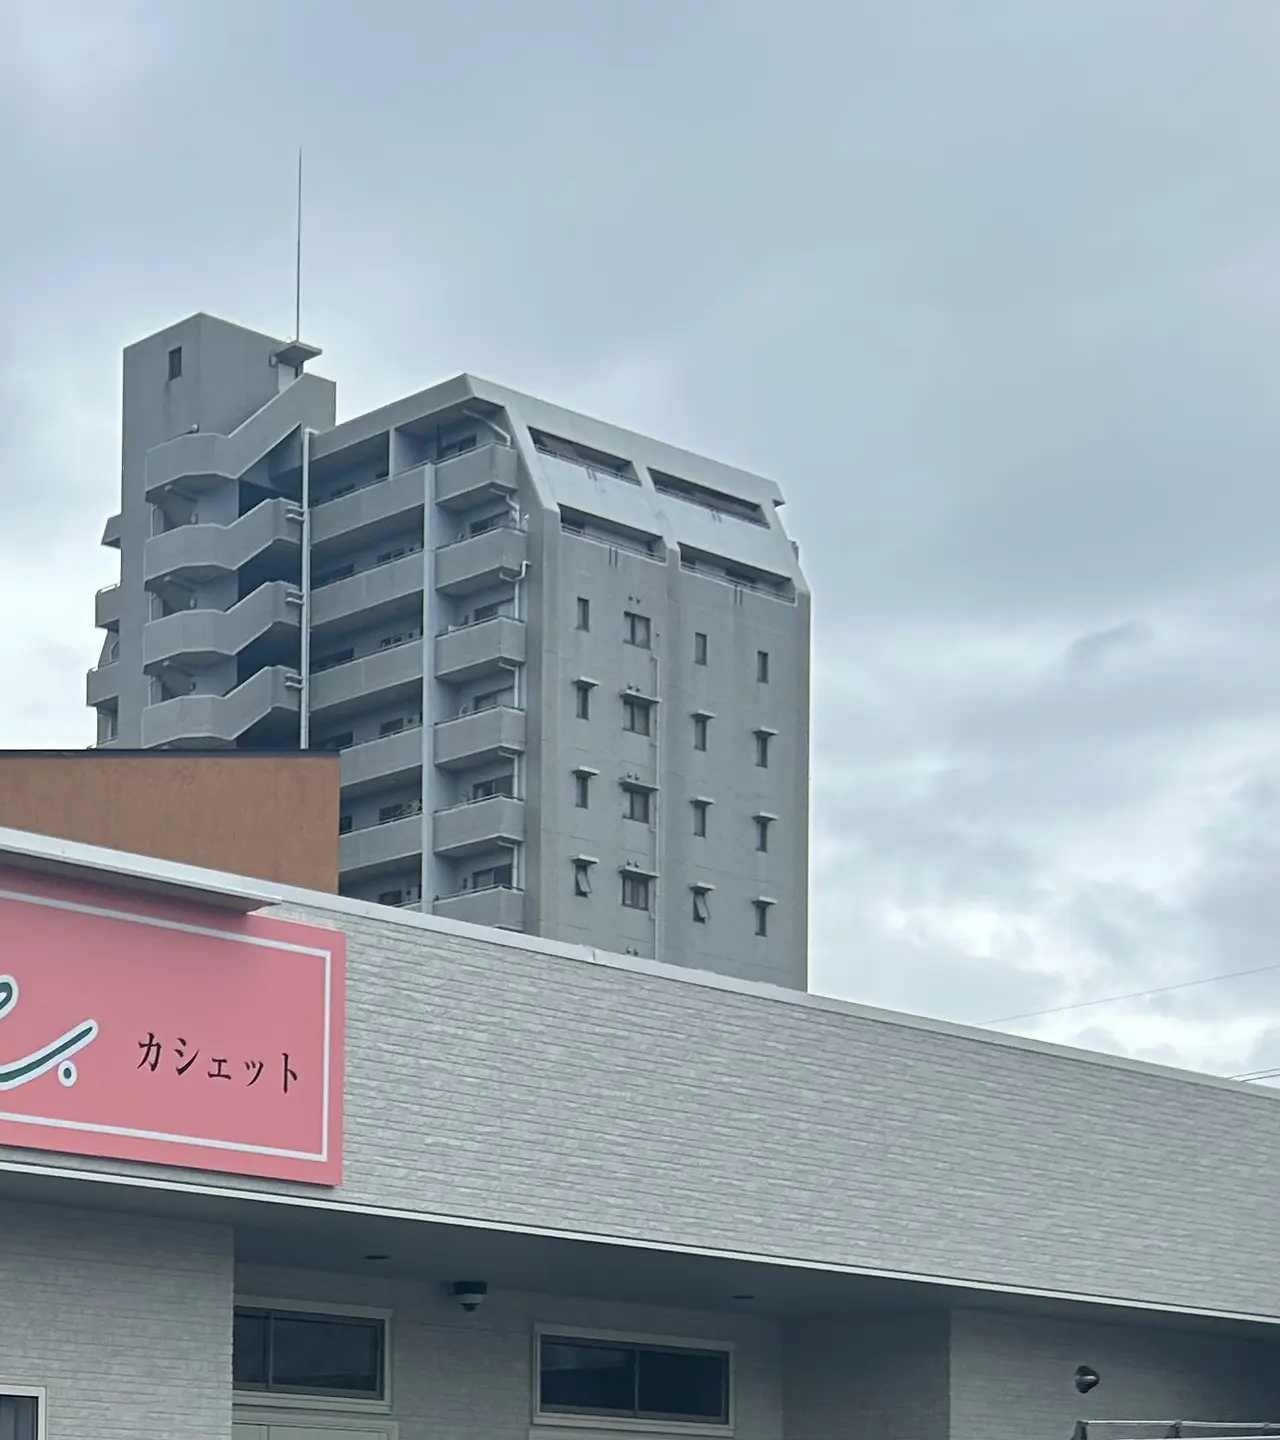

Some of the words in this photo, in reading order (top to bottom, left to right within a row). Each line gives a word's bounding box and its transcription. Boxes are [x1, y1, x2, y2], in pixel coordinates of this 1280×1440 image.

[137, 1031, 299, 1094] カシェット
